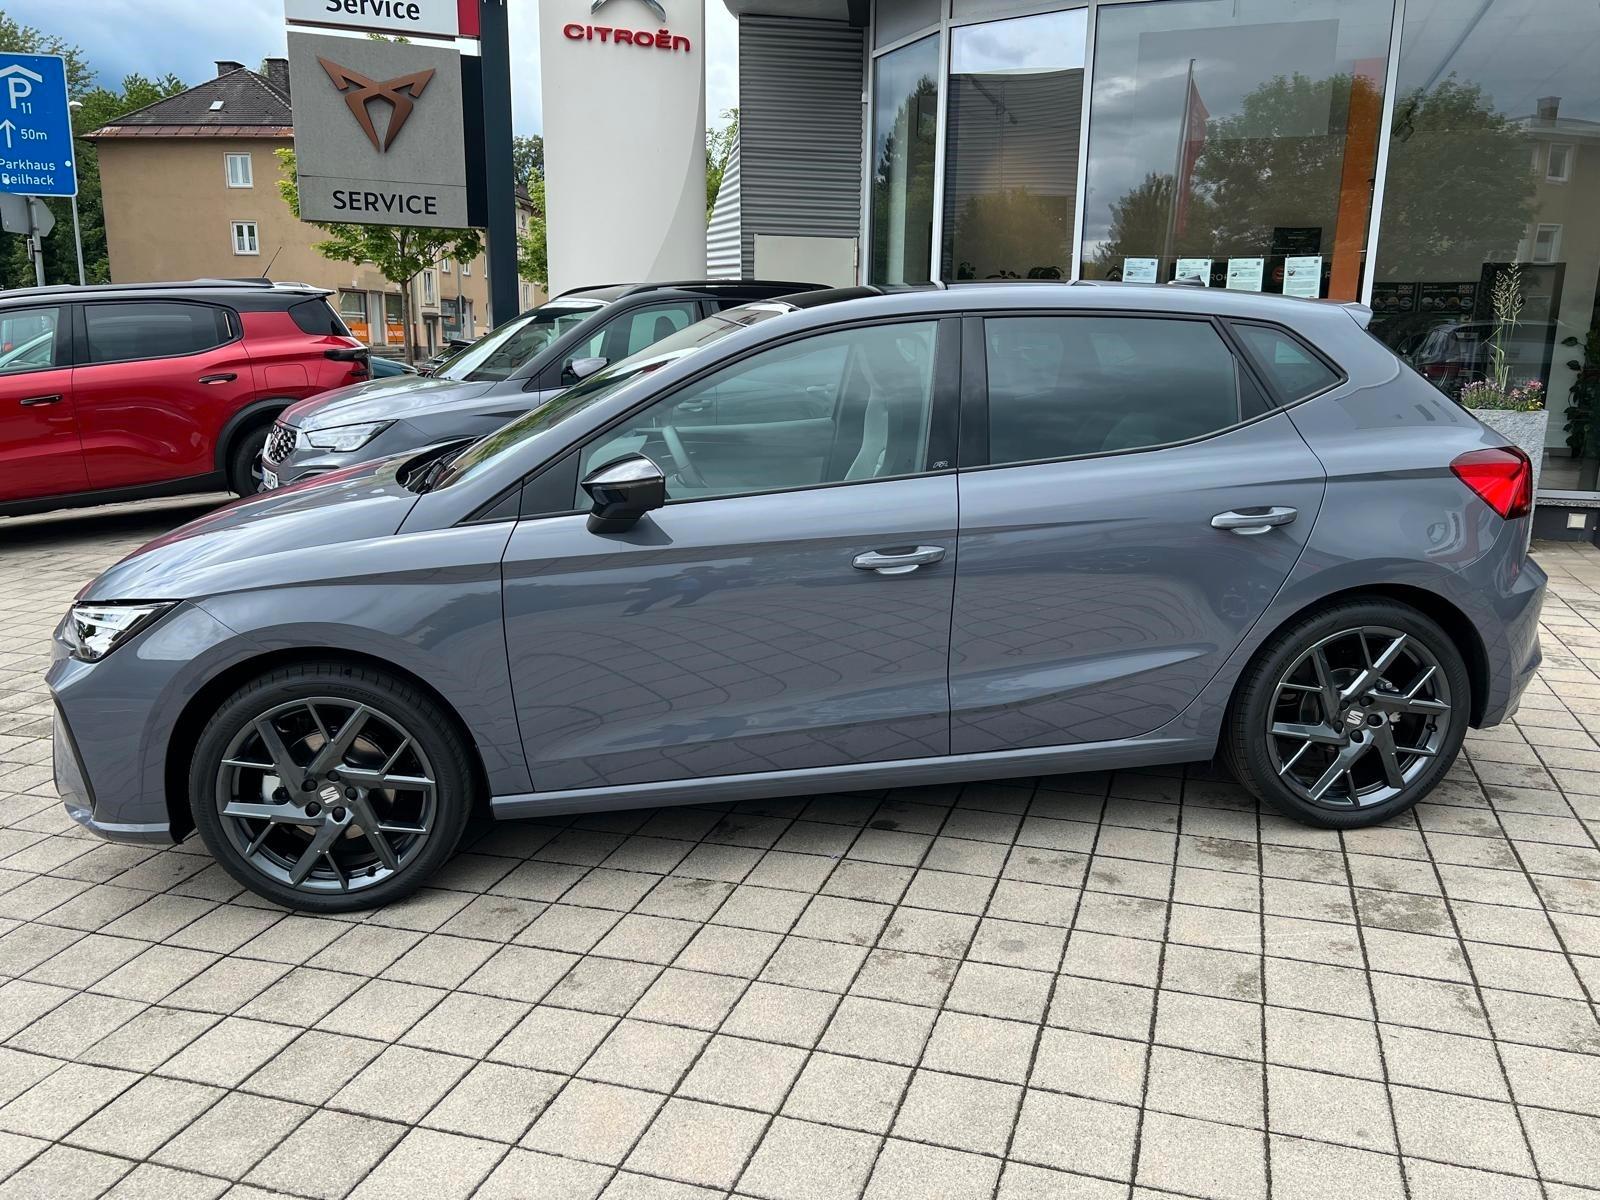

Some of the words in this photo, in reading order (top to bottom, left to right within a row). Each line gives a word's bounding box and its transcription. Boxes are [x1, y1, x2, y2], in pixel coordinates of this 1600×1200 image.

[326, 0, 420, 21] Service
[8, 77, 32, 109] P
[21, 102, 32, 114] 11
[20, 128, 48, 140] 50m
[0, 158, 56, 171] Parkhaus
[1, 173, 55, 186] Beilhack
[332, 190, 438, 215] SERVICE
